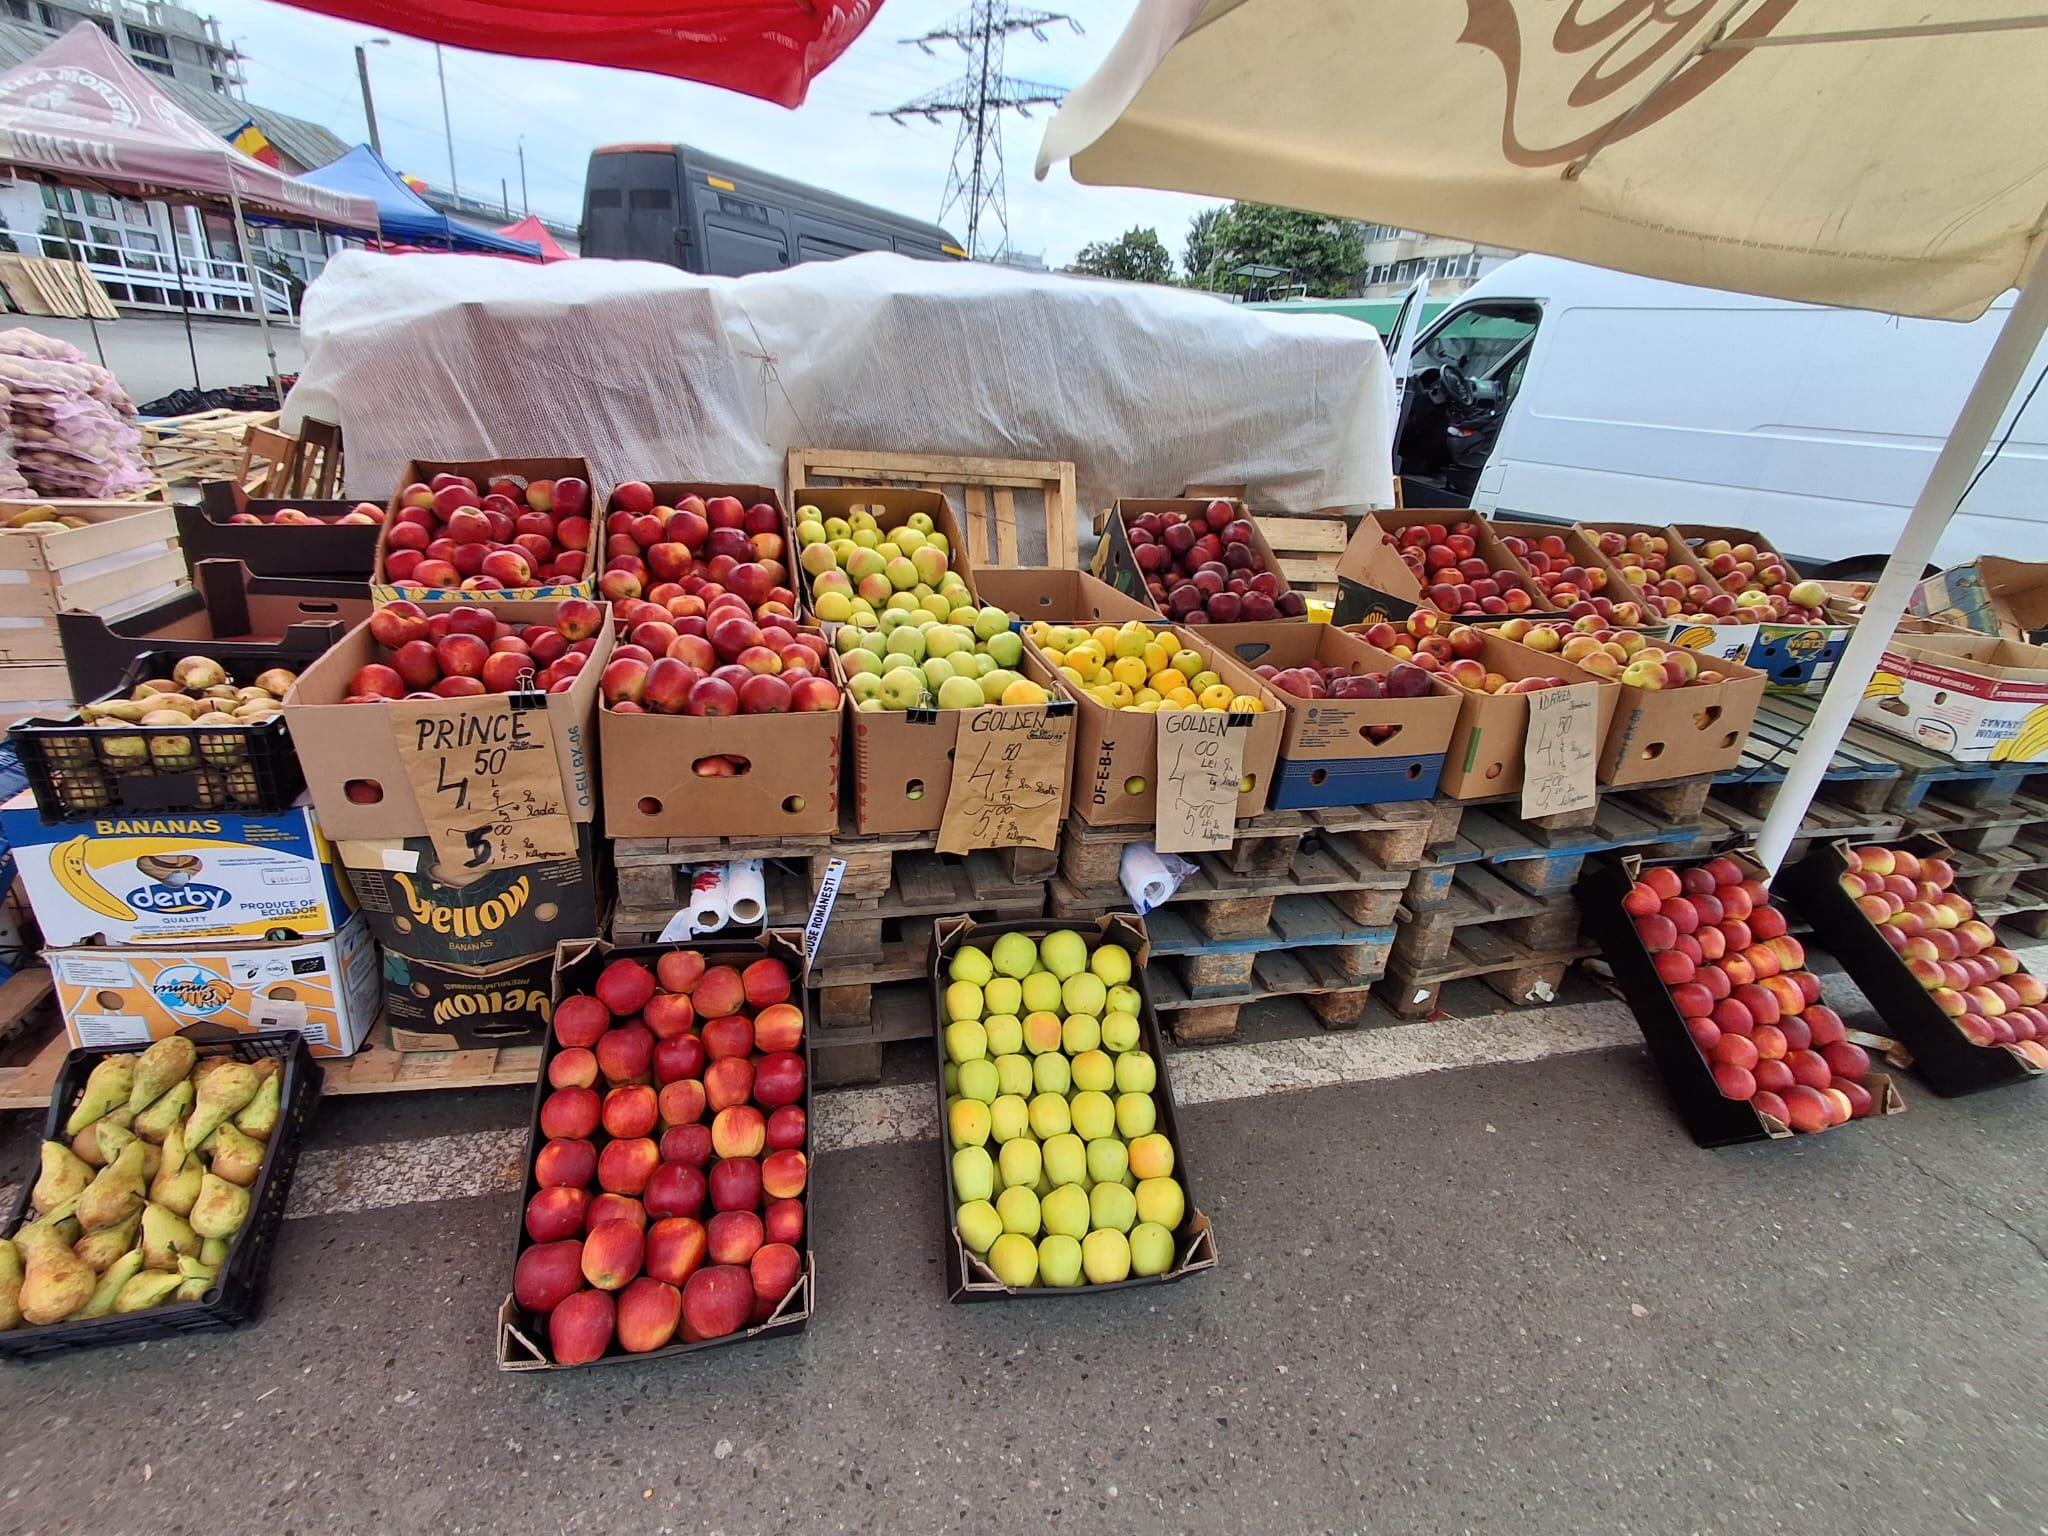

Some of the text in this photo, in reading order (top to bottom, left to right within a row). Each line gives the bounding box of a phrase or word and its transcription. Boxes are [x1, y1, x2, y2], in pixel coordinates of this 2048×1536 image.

[971, 709, 1047, 732] GOLDEN
[1166, 714, 1228, 738] GOLDEN
[416, 712, 531, 751] PRINCE
[1001, 743, 1022, 761] 50
[1194, 740, 1219, 757] 00
[474, 748, 507, 775] 50
[1092, 739, 1116, 805] DF-E-B-K
[1199, 804, 1214, 819] 00
[95, 819, 222, 835] BANANAS
[494, 824, 513, 836] 00
[132, 886, 225, 910] derby
[240, 899, 316, 910] PRODUCE OF
[261, 906, 318, 917] ECUADOR
[162, 916, 207, 924] QUALITY
[449, 939, 493, 952] BANANAS
[486, 977, 531, 992] PREMIUM
